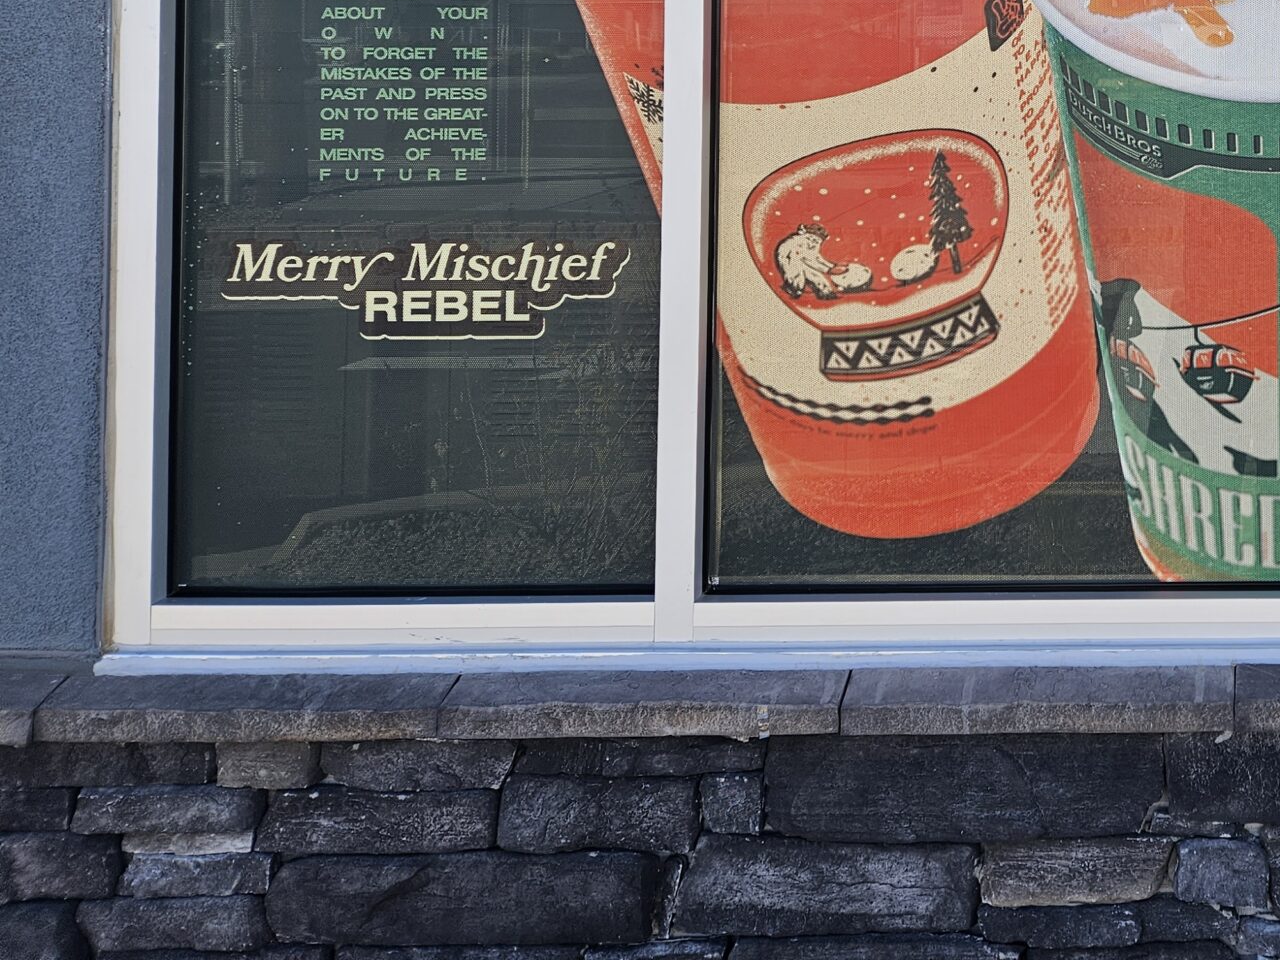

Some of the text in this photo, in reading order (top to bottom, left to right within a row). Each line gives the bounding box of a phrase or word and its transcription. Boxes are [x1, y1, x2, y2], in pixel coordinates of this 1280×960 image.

[321, 6, 488, 21] ABOUT YOUR
[321, 46, 488, 61] TO FORGET THE
[321, 67, 488, 81] MISTAKES OF THE
[320, 87, 488, 101] PAST AND PRESS
[320, 107, 488, 121] ON TO THE GREAT-
[1069, 87, 1163, 158] DUTCH BROS
[320, 127, 488, 141] ER ACHIEVE-
[319, 147, 487, 161] MENTS OF THE
[227, 241, 616, 292] Merry Mischief
[364, 290, 531, 322] REBEL
